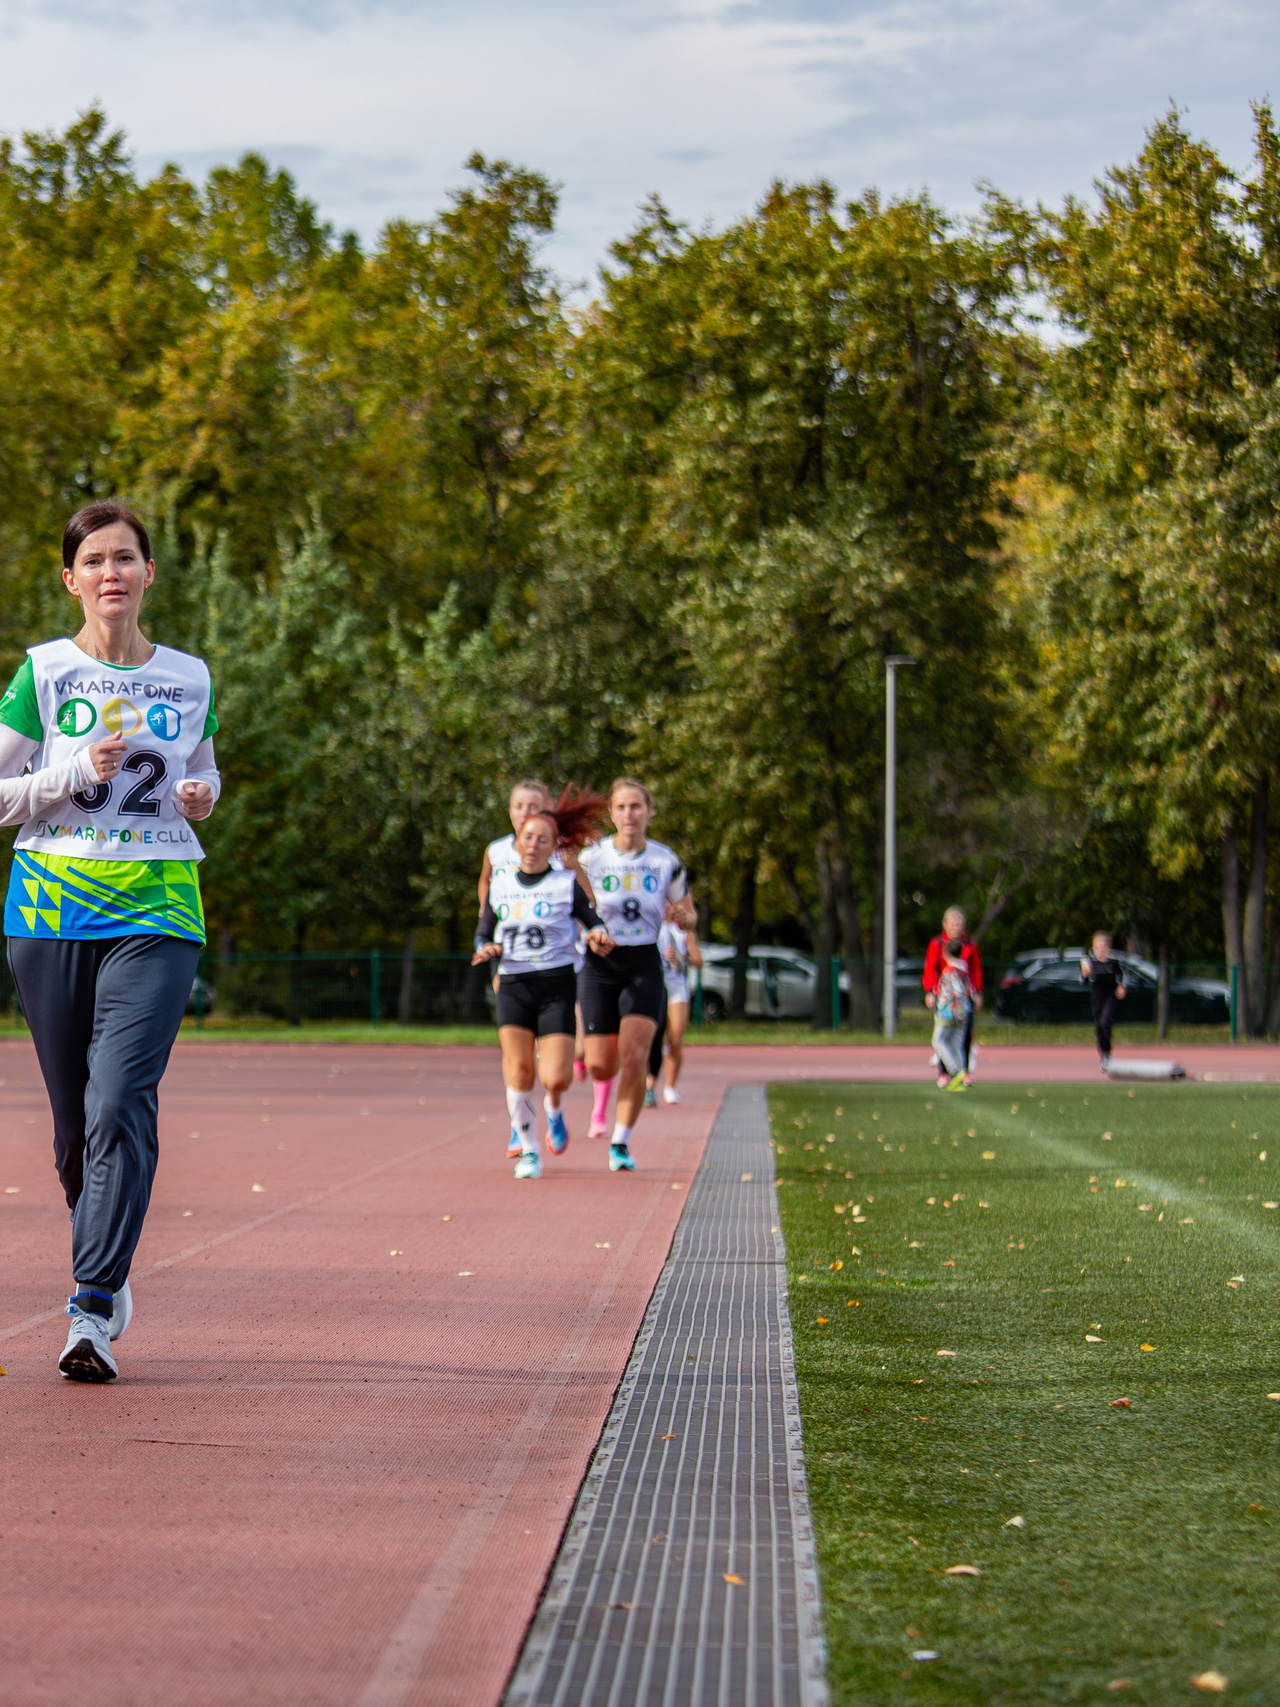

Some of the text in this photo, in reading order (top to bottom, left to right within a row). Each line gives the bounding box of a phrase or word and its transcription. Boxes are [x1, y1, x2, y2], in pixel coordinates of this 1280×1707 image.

[54, 680, 184, 703] VMARAFONE
[622, 897, 641, 924] 8
[502, 924, 546, 953] 78
